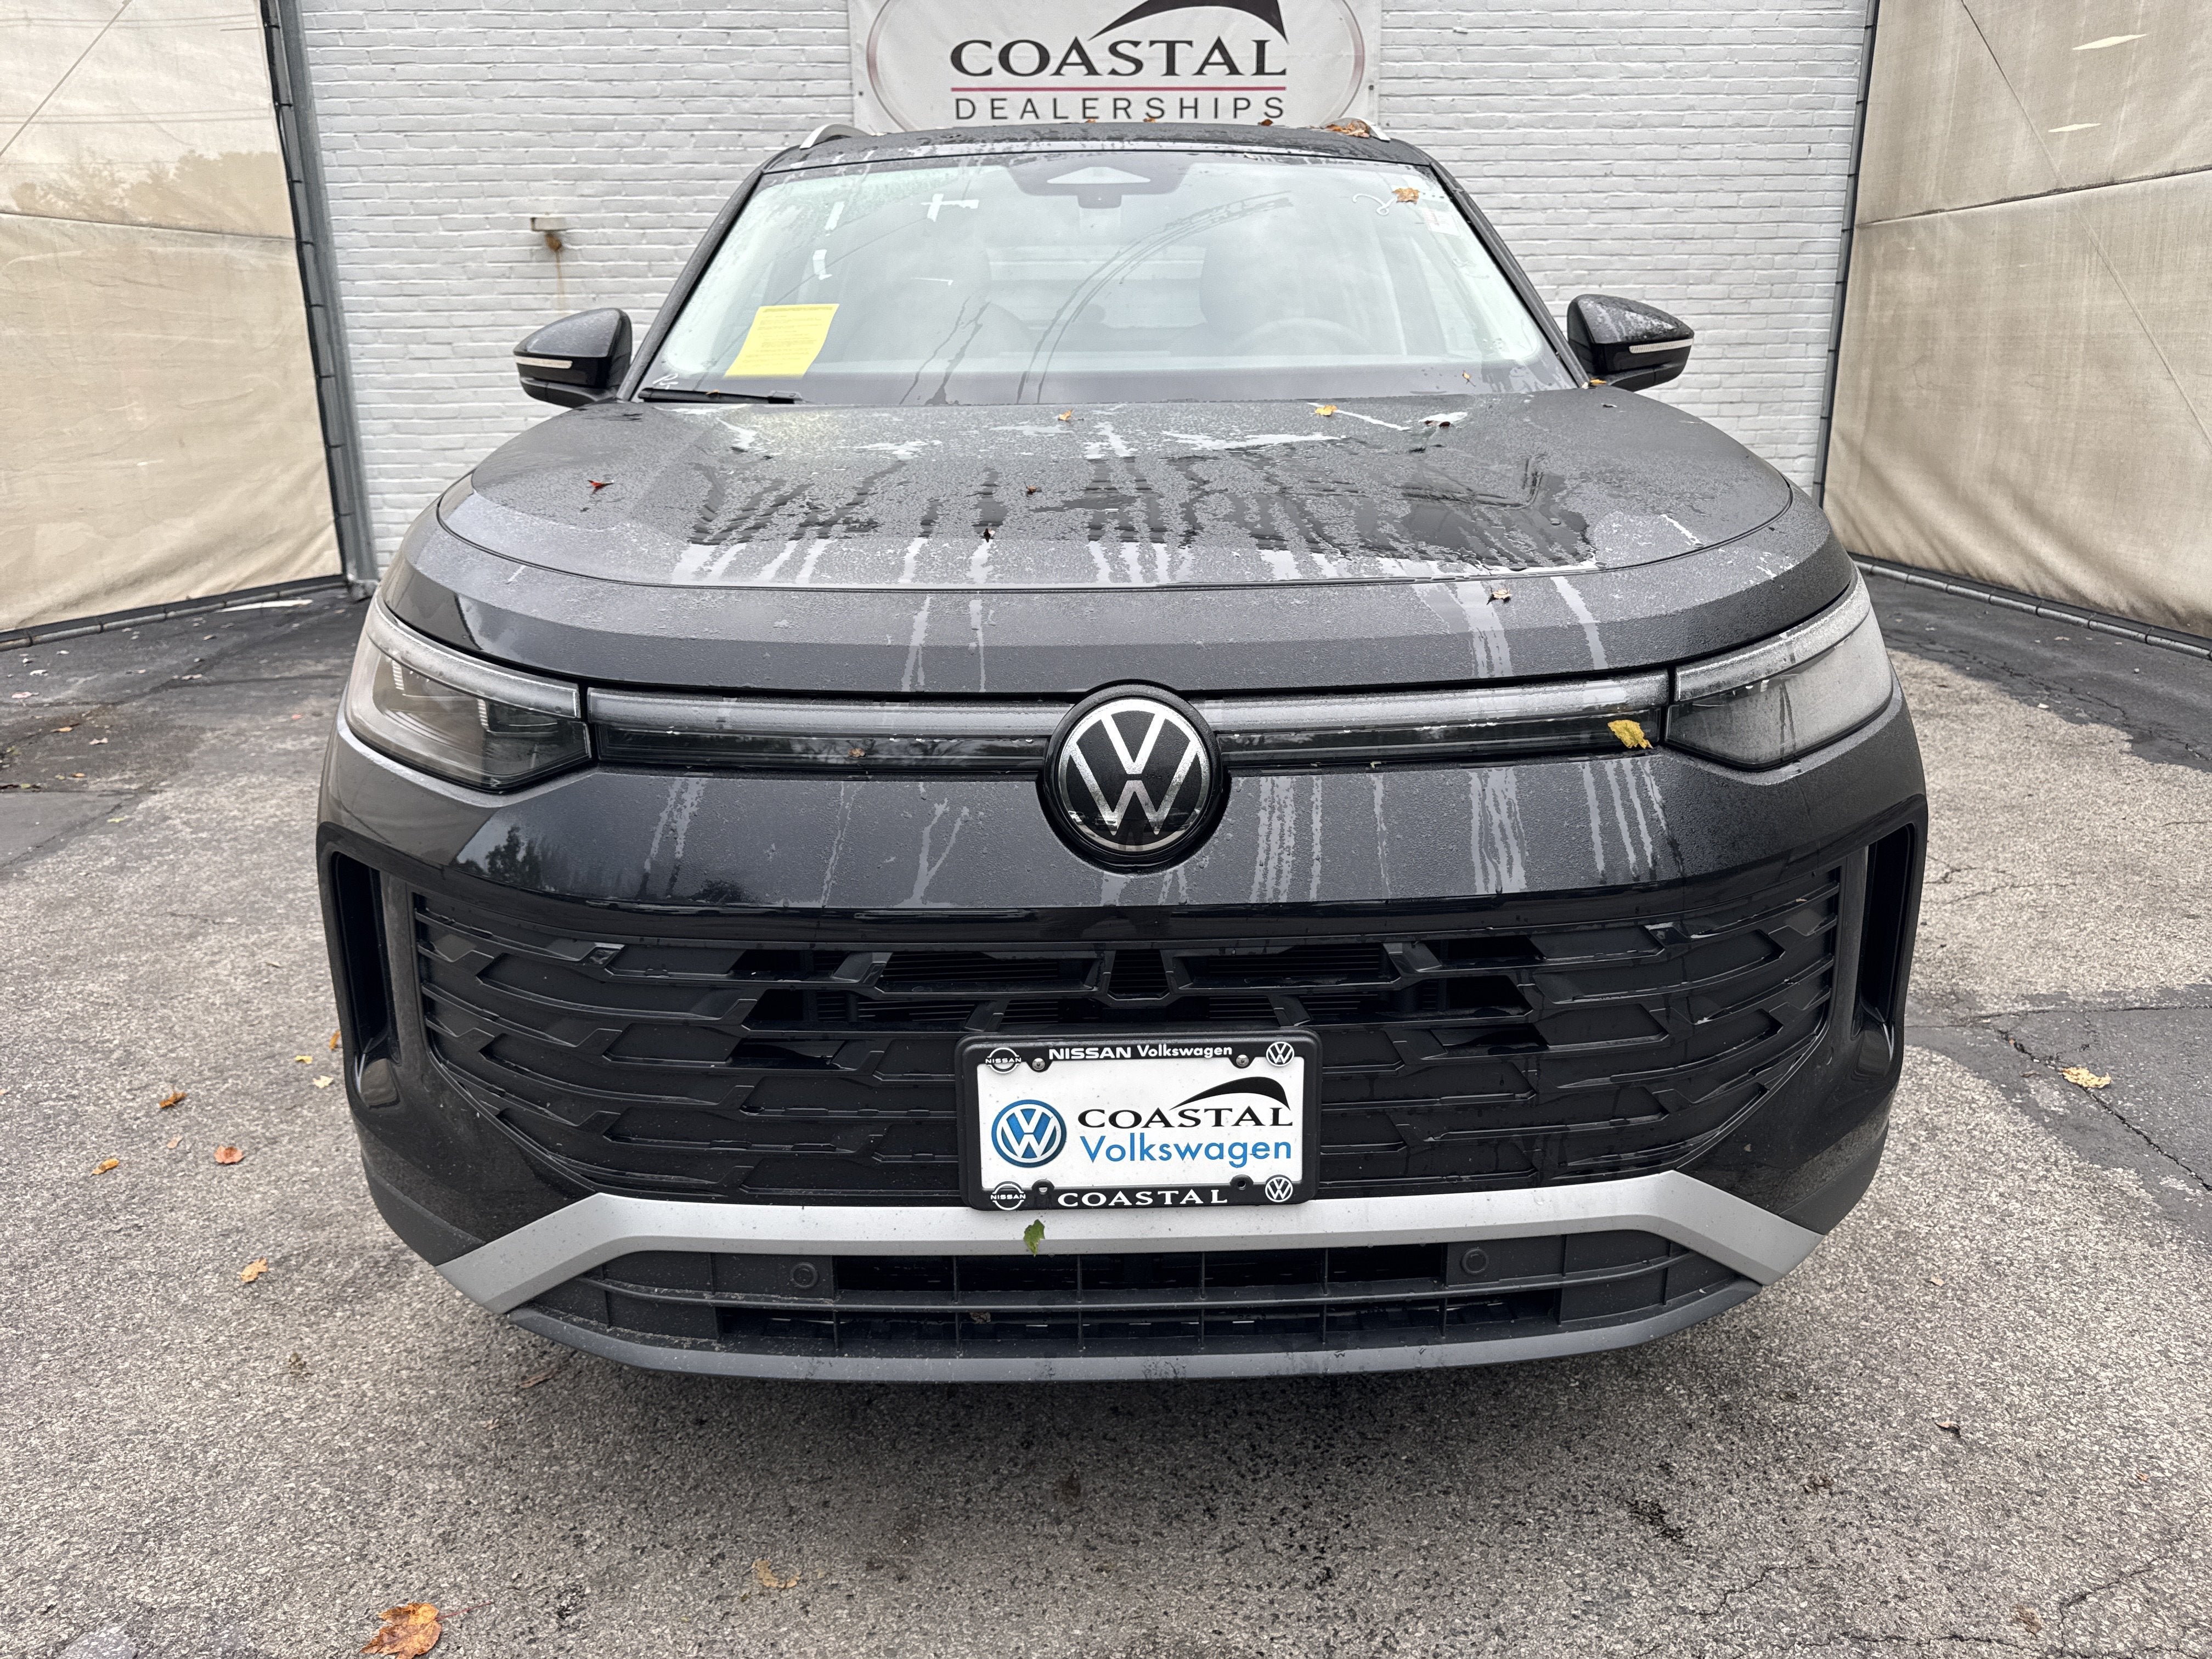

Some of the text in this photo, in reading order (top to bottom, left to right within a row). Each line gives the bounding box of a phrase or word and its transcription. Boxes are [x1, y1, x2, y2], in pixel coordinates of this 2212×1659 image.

[951, 36, 1287, 76] COASTAL
[956, 96, 1284, 120] DEALERSHIPS
[1048, 1044, 1233, 1060] NISSAN Volkswagen
[1077, 1105, 1293, 1129] COASTAL
[1079, 1132, 1291, 1168] Volkswagen
[1057, 1189, 1228, 1207] COASTAL
